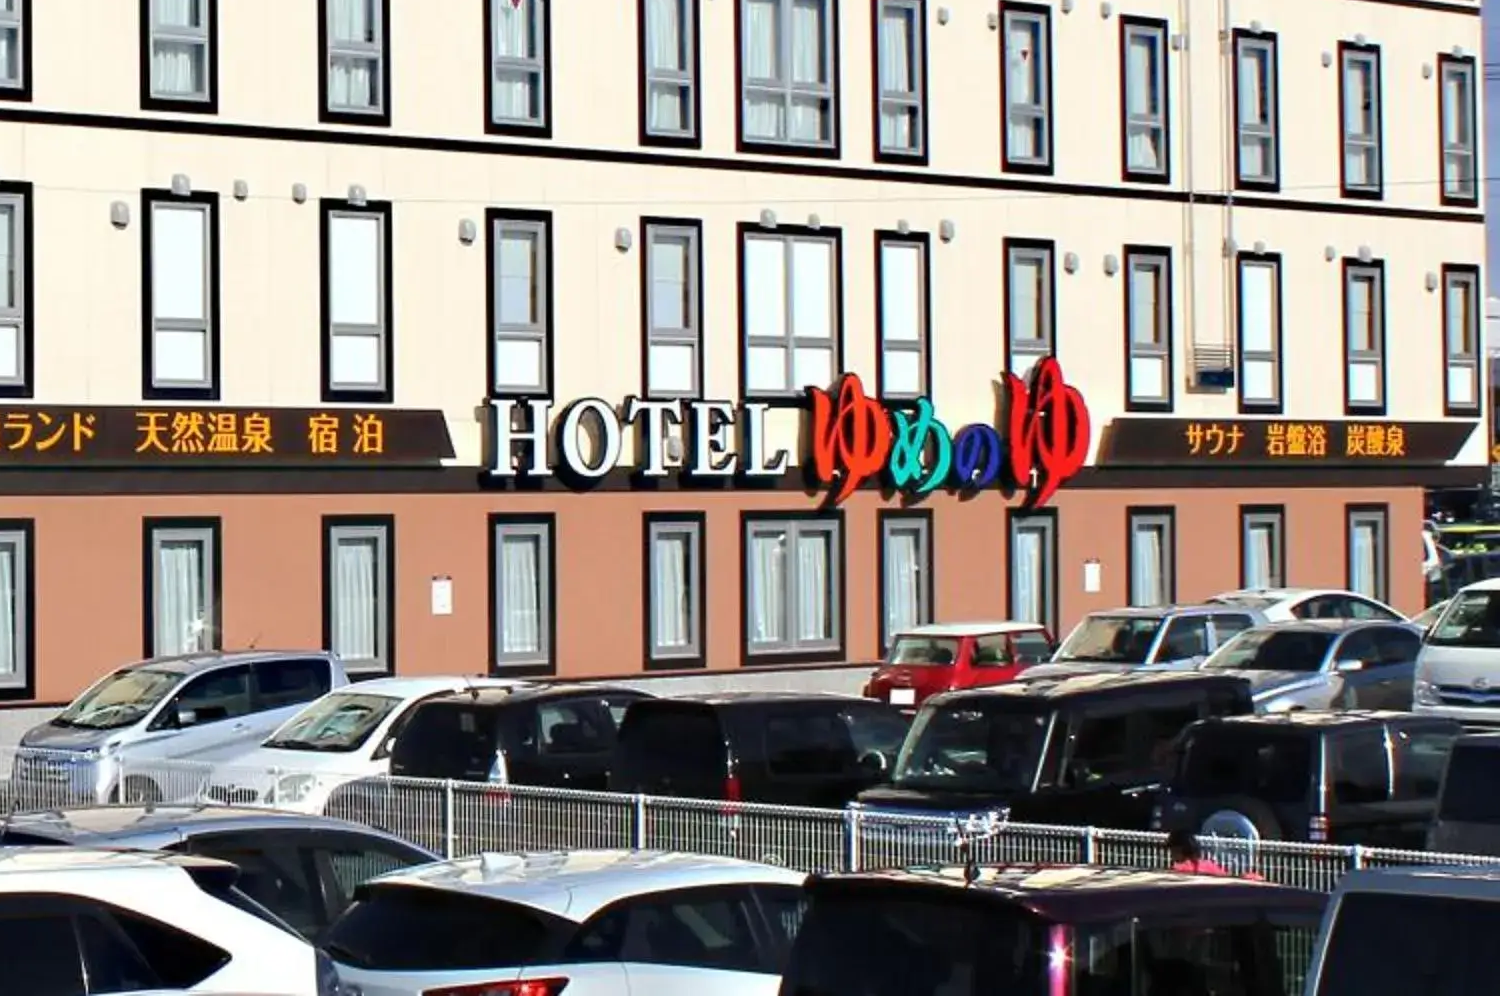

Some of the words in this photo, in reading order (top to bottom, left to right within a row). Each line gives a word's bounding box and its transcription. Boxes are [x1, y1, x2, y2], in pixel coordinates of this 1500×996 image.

[135, 411, 274, 453] 天然温泉
[484, 397, 788, 476] HOTEL
[803, 355, 1090, 508] ゆめのゆ
[1185, 423, 1244, 454] サウナ
[1266, 424, 1327, 456] 岩盤浴
[1346, 424, 1405, 457] 炭酸泉
